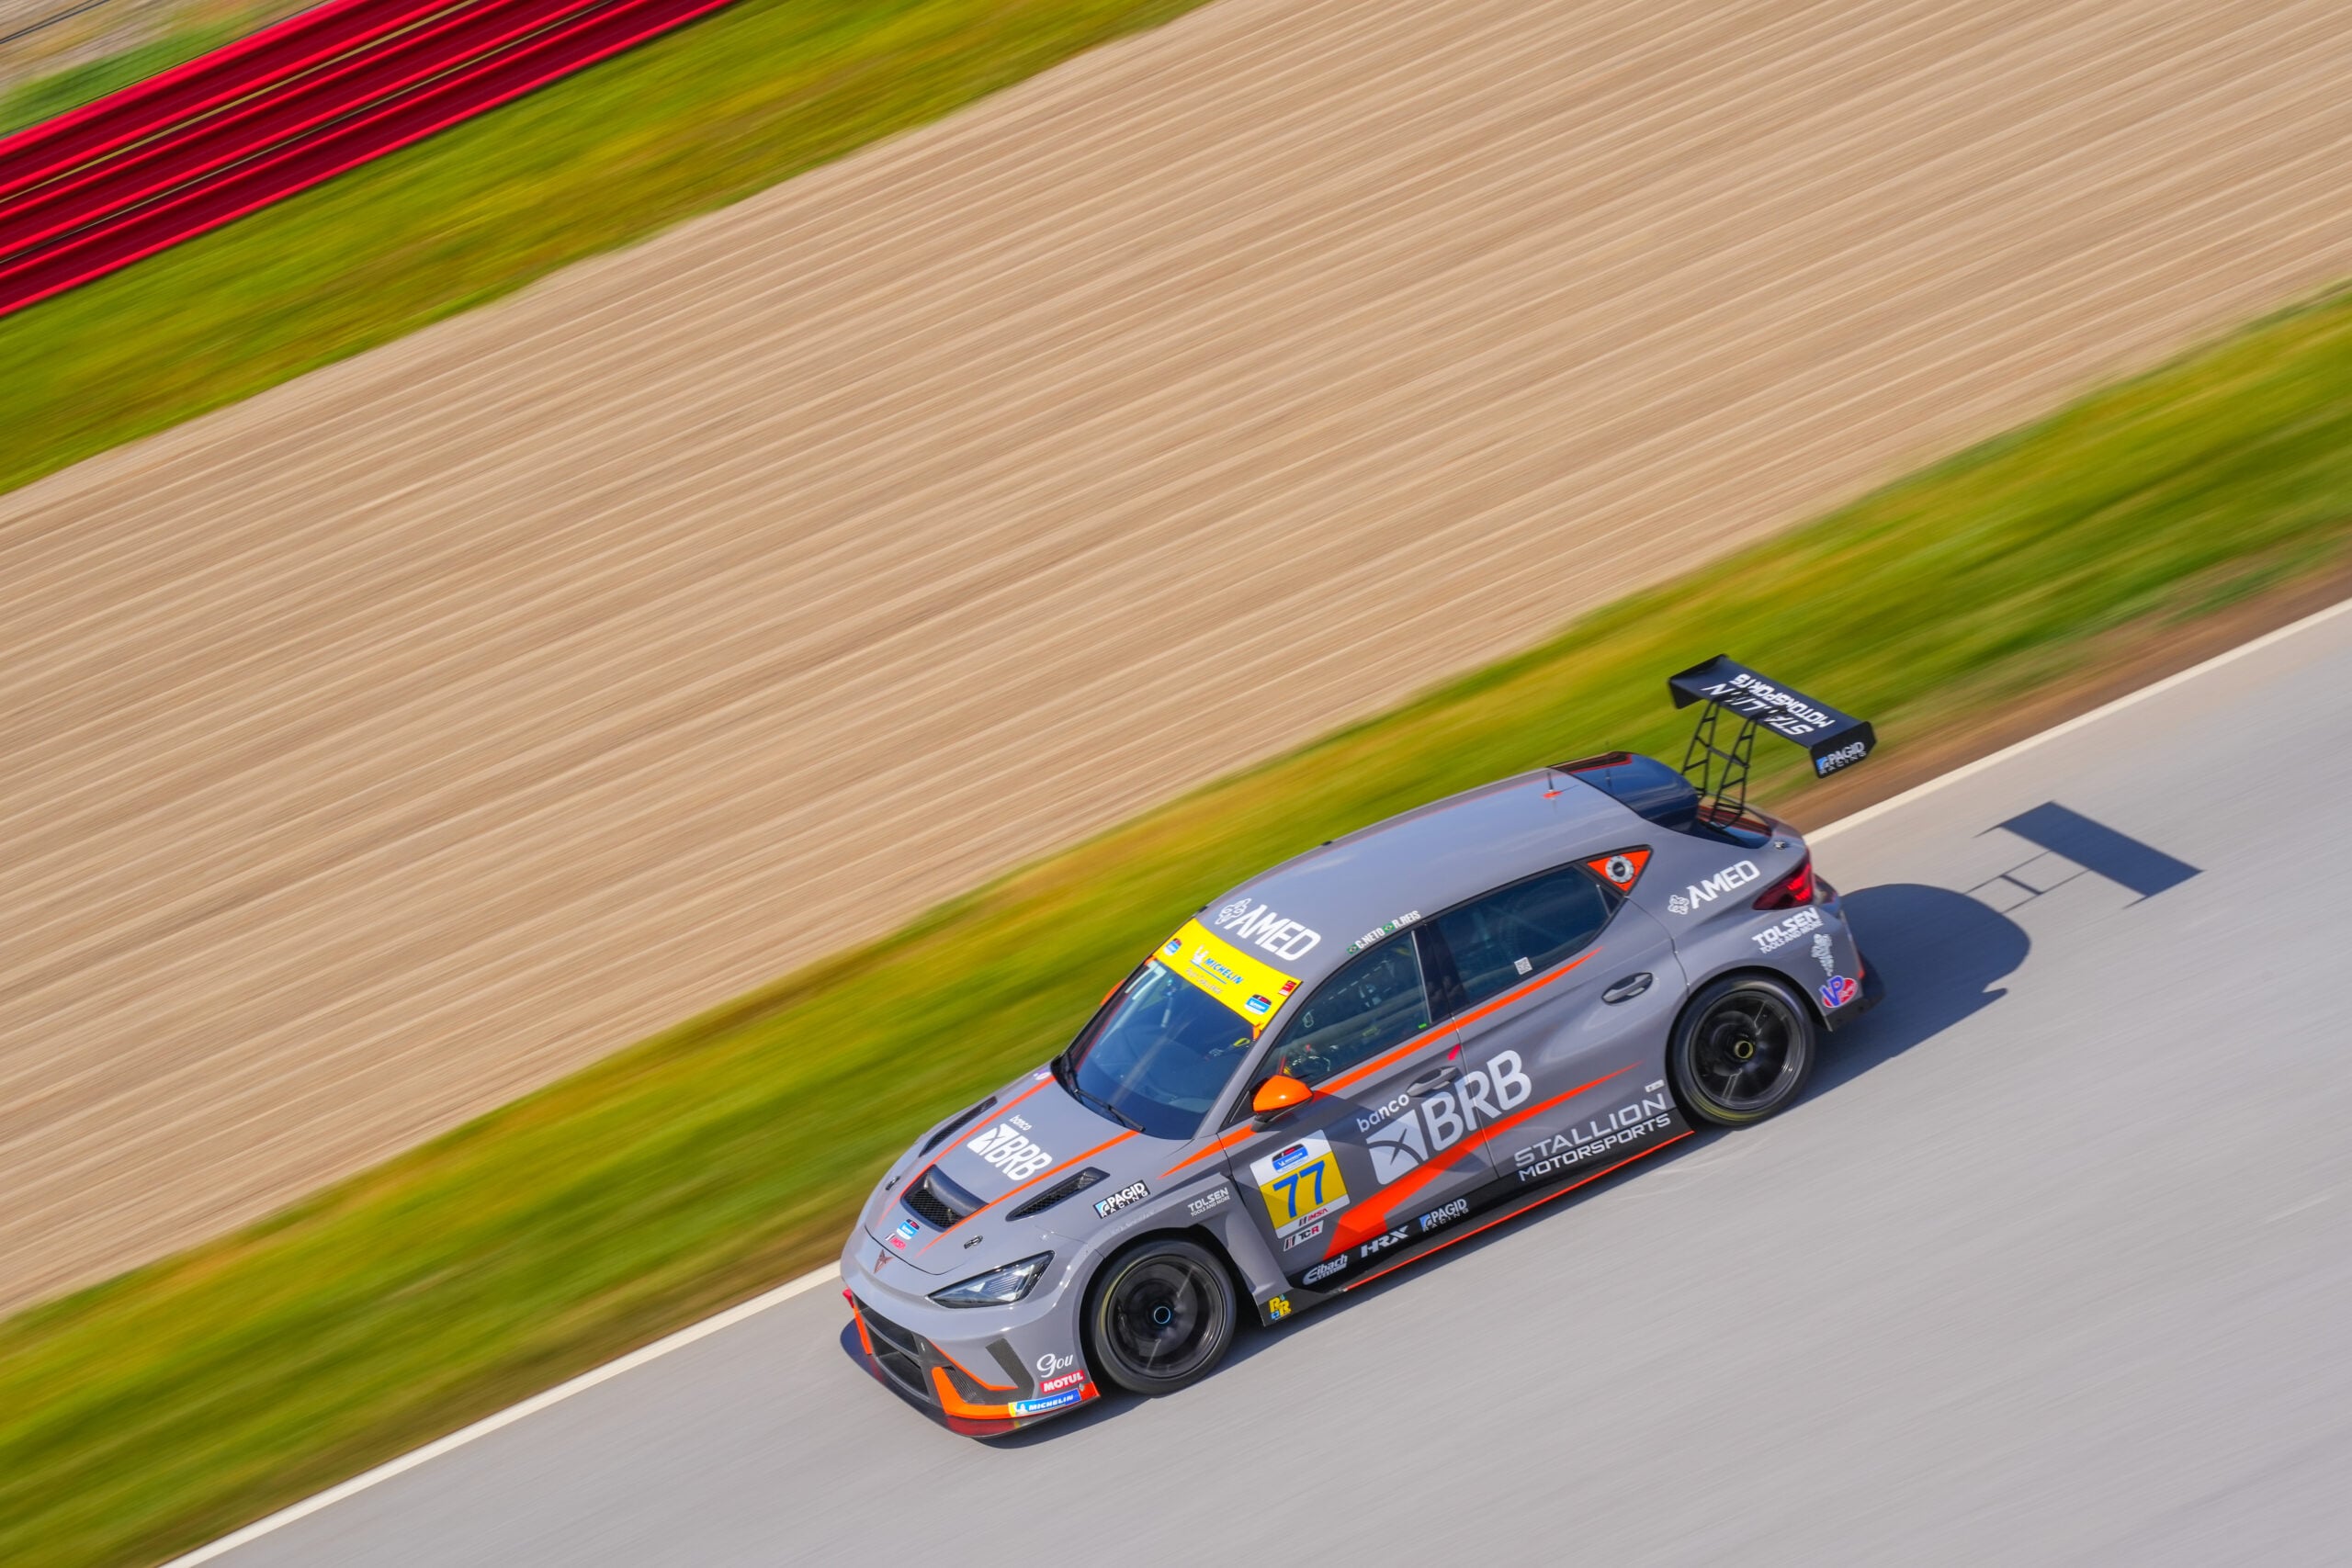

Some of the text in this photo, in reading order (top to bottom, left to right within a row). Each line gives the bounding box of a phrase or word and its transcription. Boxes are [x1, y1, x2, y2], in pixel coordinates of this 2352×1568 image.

[1827, 741, 1865, 765] PAGID
[1686, 860, 1760, 909] AMED
[1223, 904, 1321, 961] AMED
[1751, 908, 1820, 947] TOLSEN
[1204, 957, 1243, 985] MICHELIN
[1356, 1094, 1409, 1133] banco
[1421, 1050, 1532, 1151] BRB
[1514, 1093, 1667, 1168] STALLION
[984, 1135, 1053, 1181] BRB
[1519, 1113, 1671, 1181] MOTORSPORTS
[1102, 1190, 1148, 1218] RACING
[1107, 1182, 1145, 1208] PAGID
[1187, 1187, 1229, 1213] TOLSEN
[1272, 1160, 1326, 1219] 77
[1431, 1199, 1467, 1223] PAGID
[1298, 1225, 1319, 1240] TCR
[1361, 1225, 1409, 1258] HRX
[1303, 1254, 1348, 1285] Eibach
[1043, 1372, 1083, 1393] MOTUL
[1029, 1394, 1074, 1411] MICHELIN
